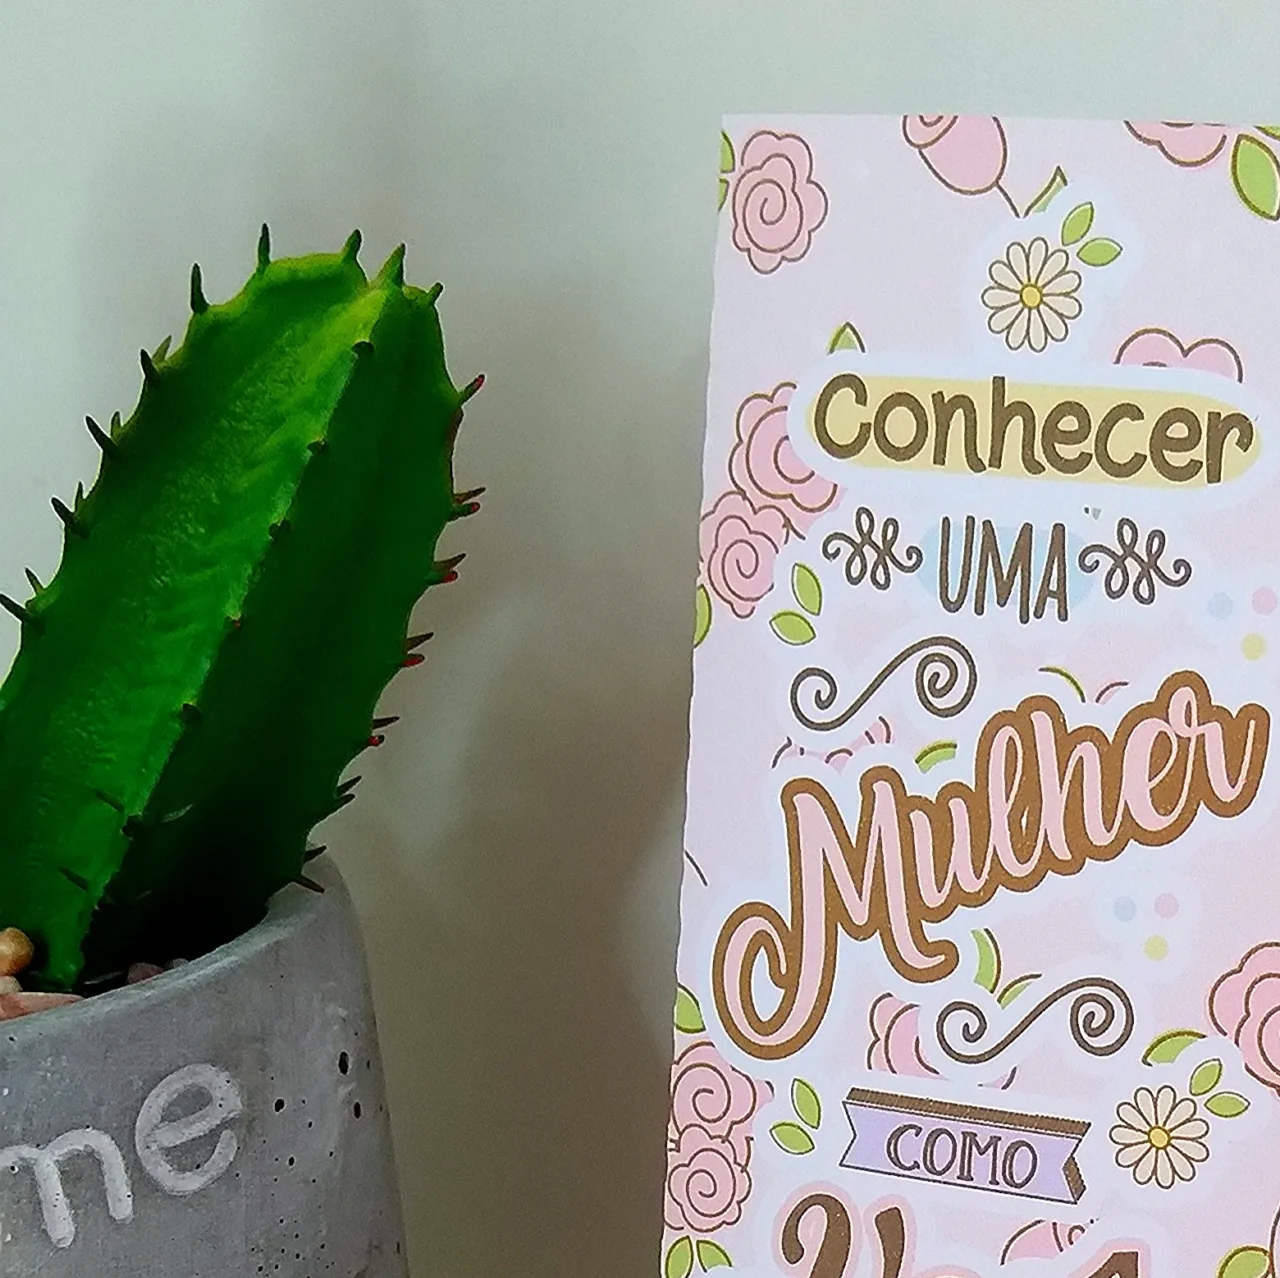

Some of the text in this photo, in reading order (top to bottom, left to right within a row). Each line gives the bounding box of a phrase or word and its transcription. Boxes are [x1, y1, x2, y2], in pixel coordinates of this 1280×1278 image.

[814, 373, 1254, 484] Conhecer
[938, 516, 1068, 623] UMA
[712, 670, 1271, 1060] Mulher
[886, 1123, 1038, 1188] COMO
